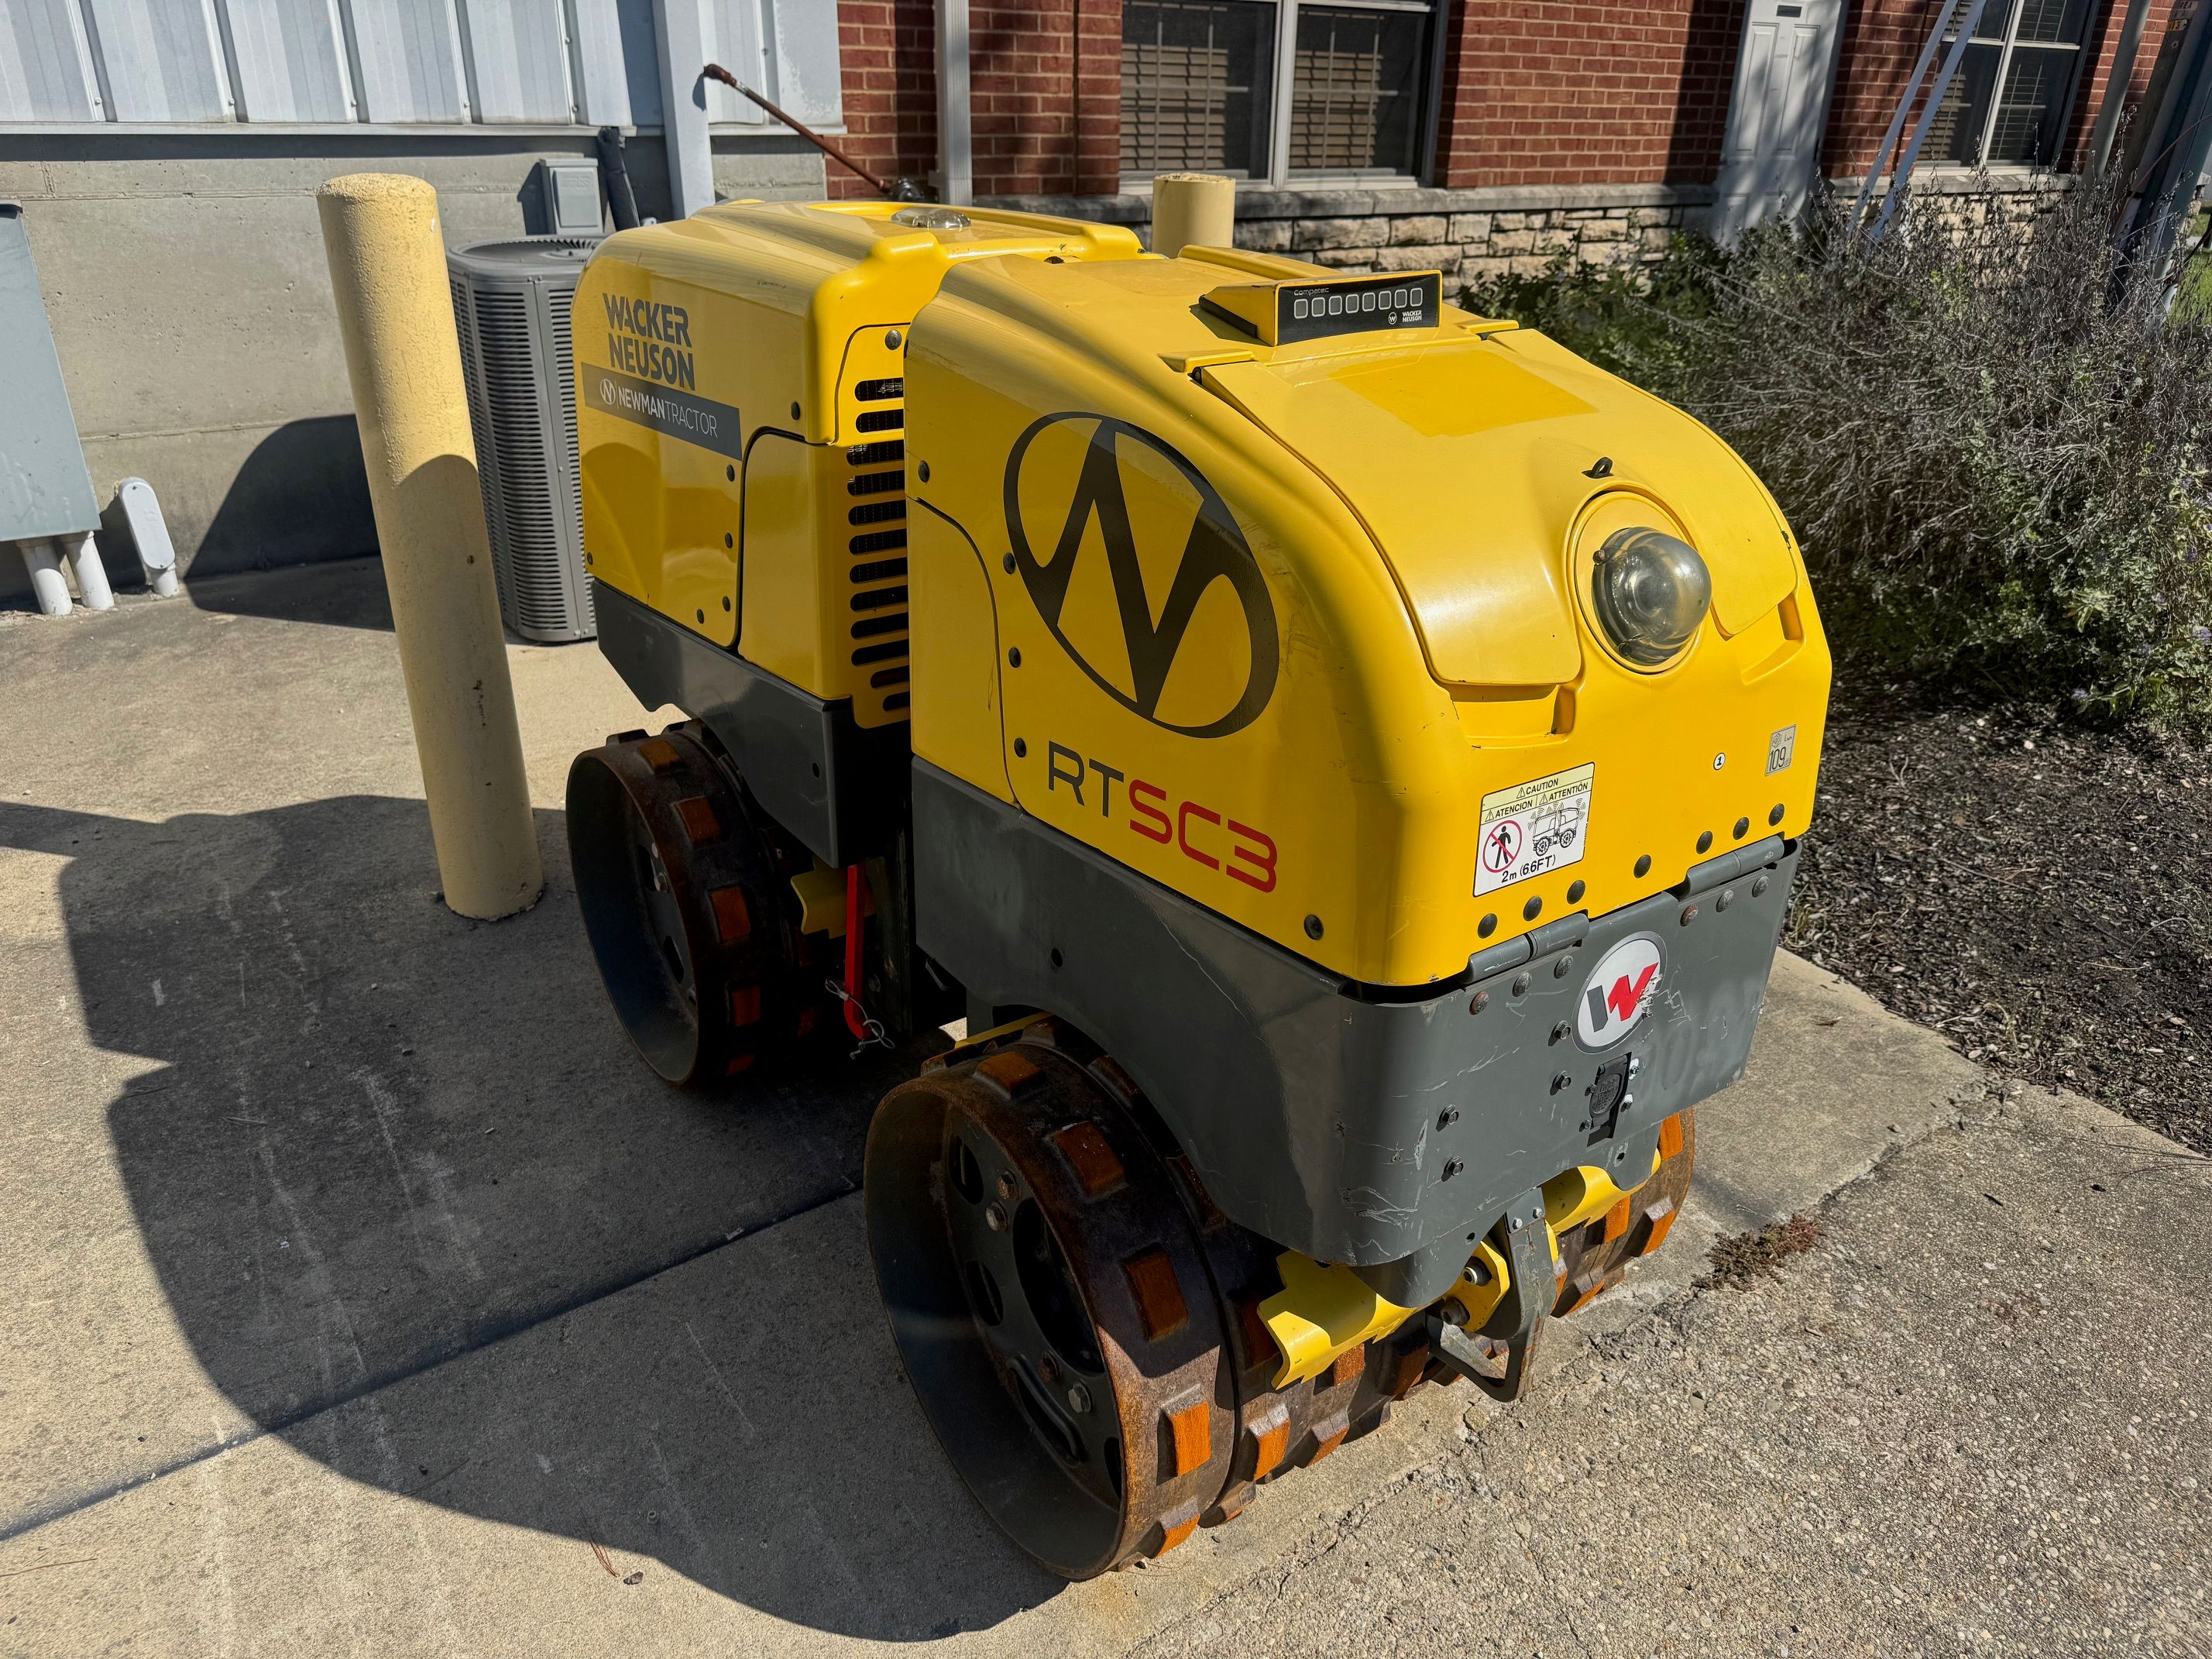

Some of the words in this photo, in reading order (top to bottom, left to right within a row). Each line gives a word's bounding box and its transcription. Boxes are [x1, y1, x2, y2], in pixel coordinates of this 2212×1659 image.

[1293, 287, 1329, 296] Compatec
[603, 293, 692, 348] WACKER
[608, 333, 696, 391] NEUSON
[618, 386, 718, 438] NEWMANTRACTOR
[1716, 756, 1723, 766] 1
[1769, 747, 1786, 771] 109
[1526, 778, 1559, 795] CAUTION
[1048, 740, 1278, 893] RTSC3
[1495, 799, 1533, 818] ATENCION
